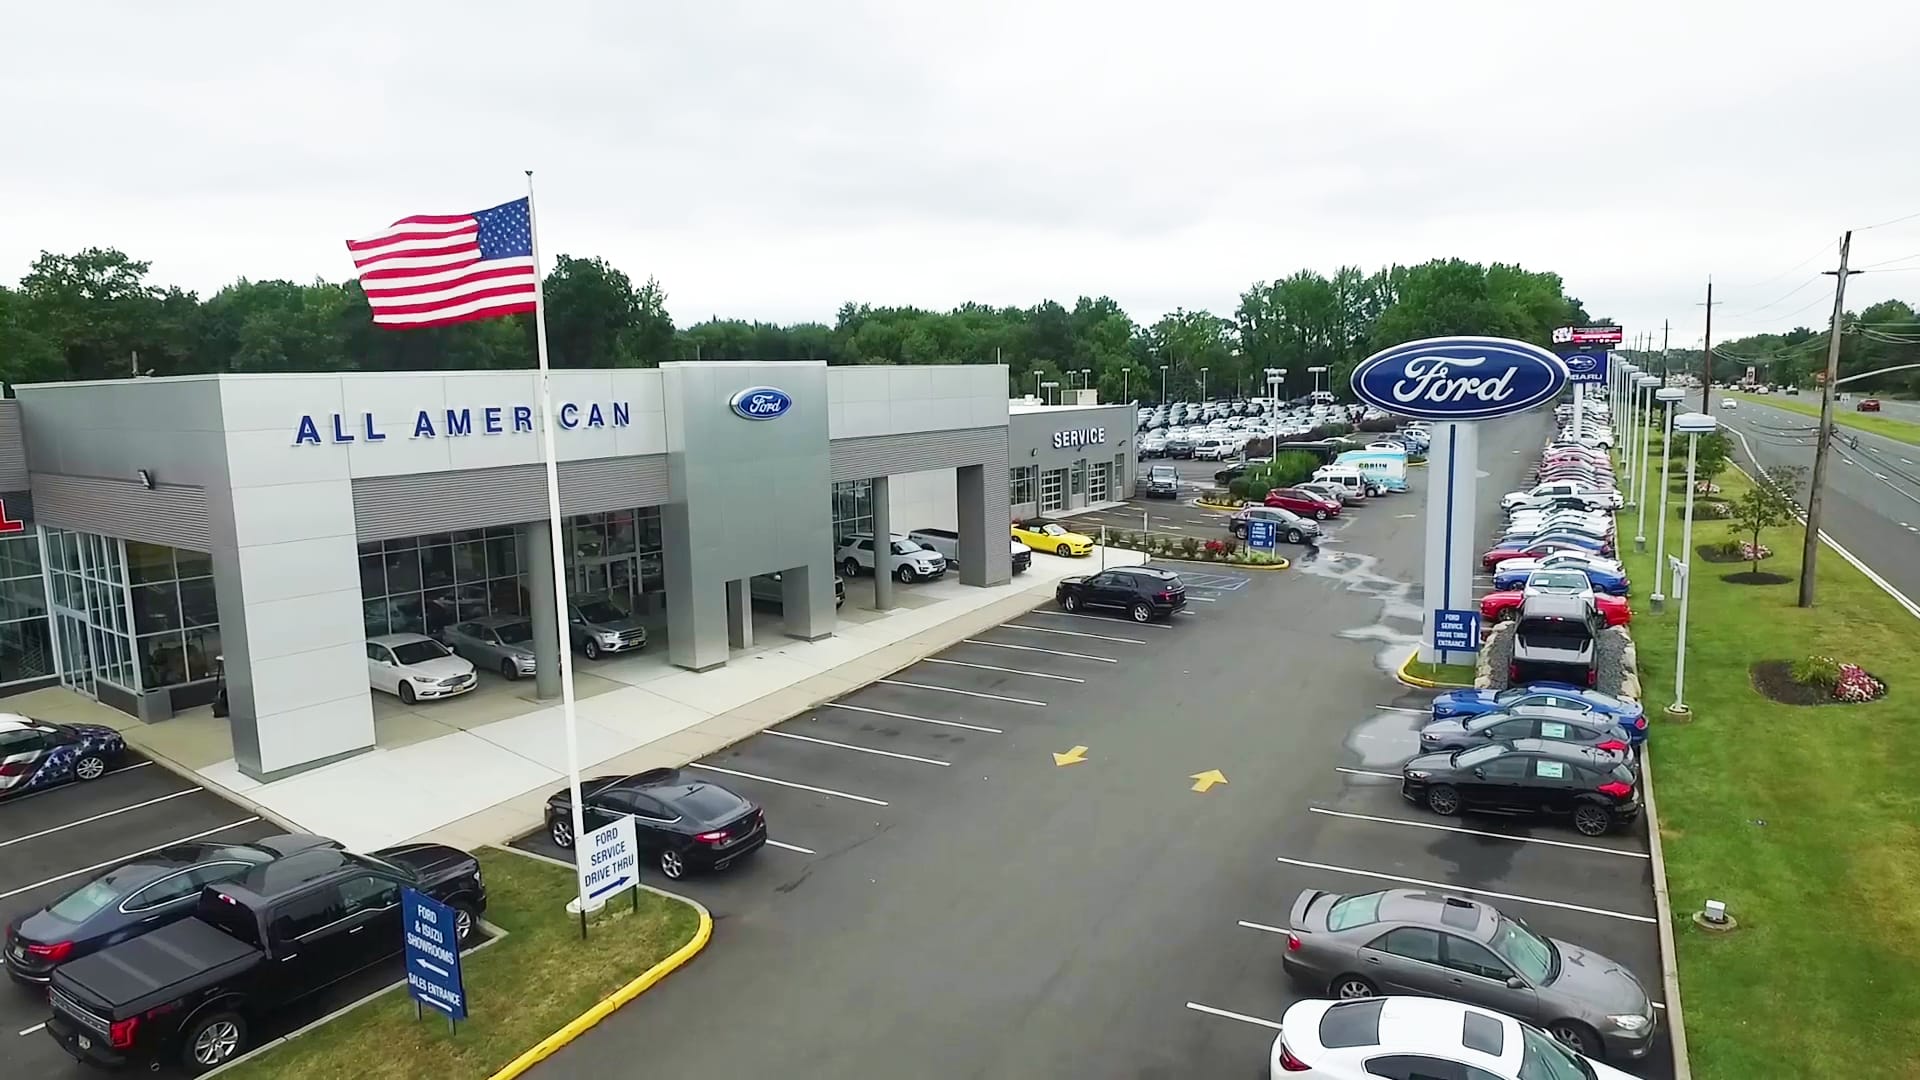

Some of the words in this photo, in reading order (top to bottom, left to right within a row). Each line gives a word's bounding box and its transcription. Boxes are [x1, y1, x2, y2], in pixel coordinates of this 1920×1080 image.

[1393, 356, 1518, 402] Ford
[749, 394, 782, 413] Ford
[295, 412, 386, 445] ALL
[413, 401, 630, 438] AMERCAN
[1053, 427, 1105, 449] SERVICE
[595, 827, 618, 847] FORD
[590, 840, 626, 867] SERVICE
[584, 865, 611, 887] DRIVE
[612, 854, 634, 874] THRU
[417, 904, 437, 924] FORD
[414, 920, 421, 933] &
[421, 923, 443, 944] ISUZU
[407, 932, 455, 965] SHOWROOMS
[408, 972, 427, 991] SALES
[427, 982, 461, 1007] ENTRANCE
